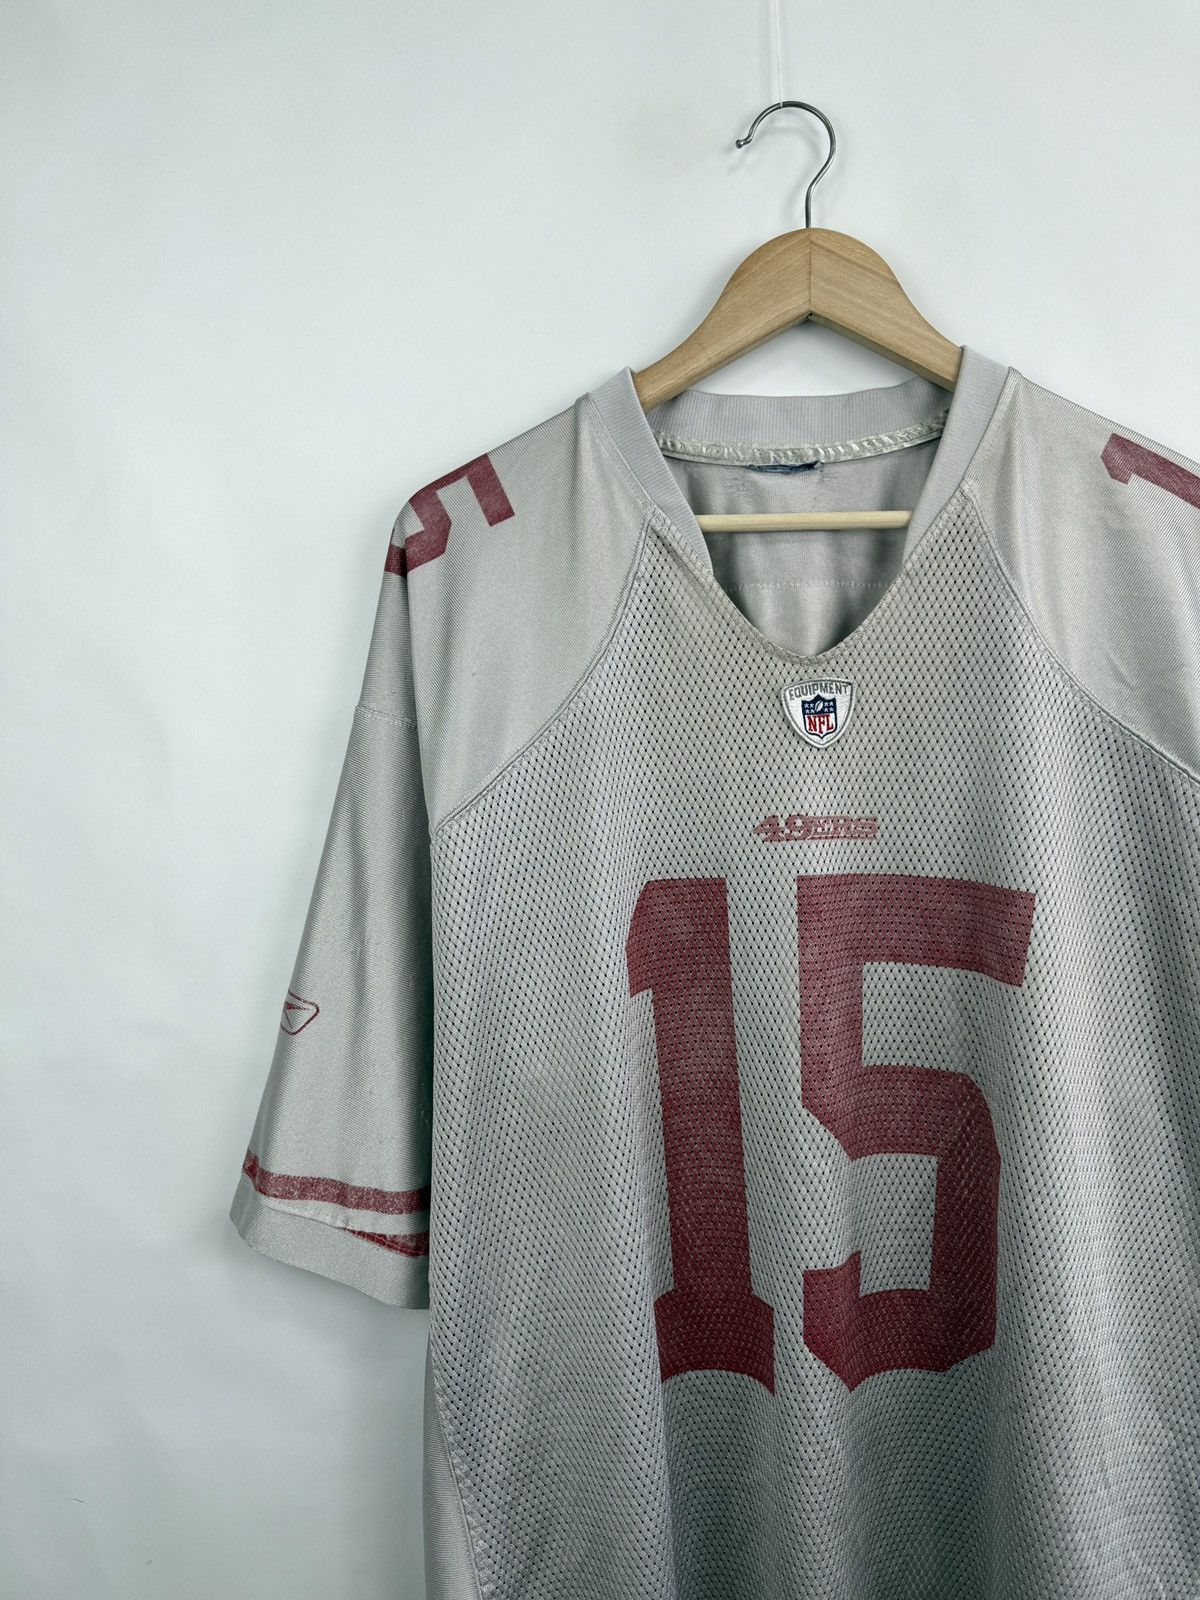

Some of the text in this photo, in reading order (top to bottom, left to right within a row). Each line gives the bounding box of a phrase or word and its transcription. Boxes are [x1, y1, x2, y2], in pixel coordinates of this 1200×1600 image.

[788, 682, 849, 701] EQUIPMENT
[806, 714, 834, 735] NFL
[625, 873, 1037, 1397] 15
